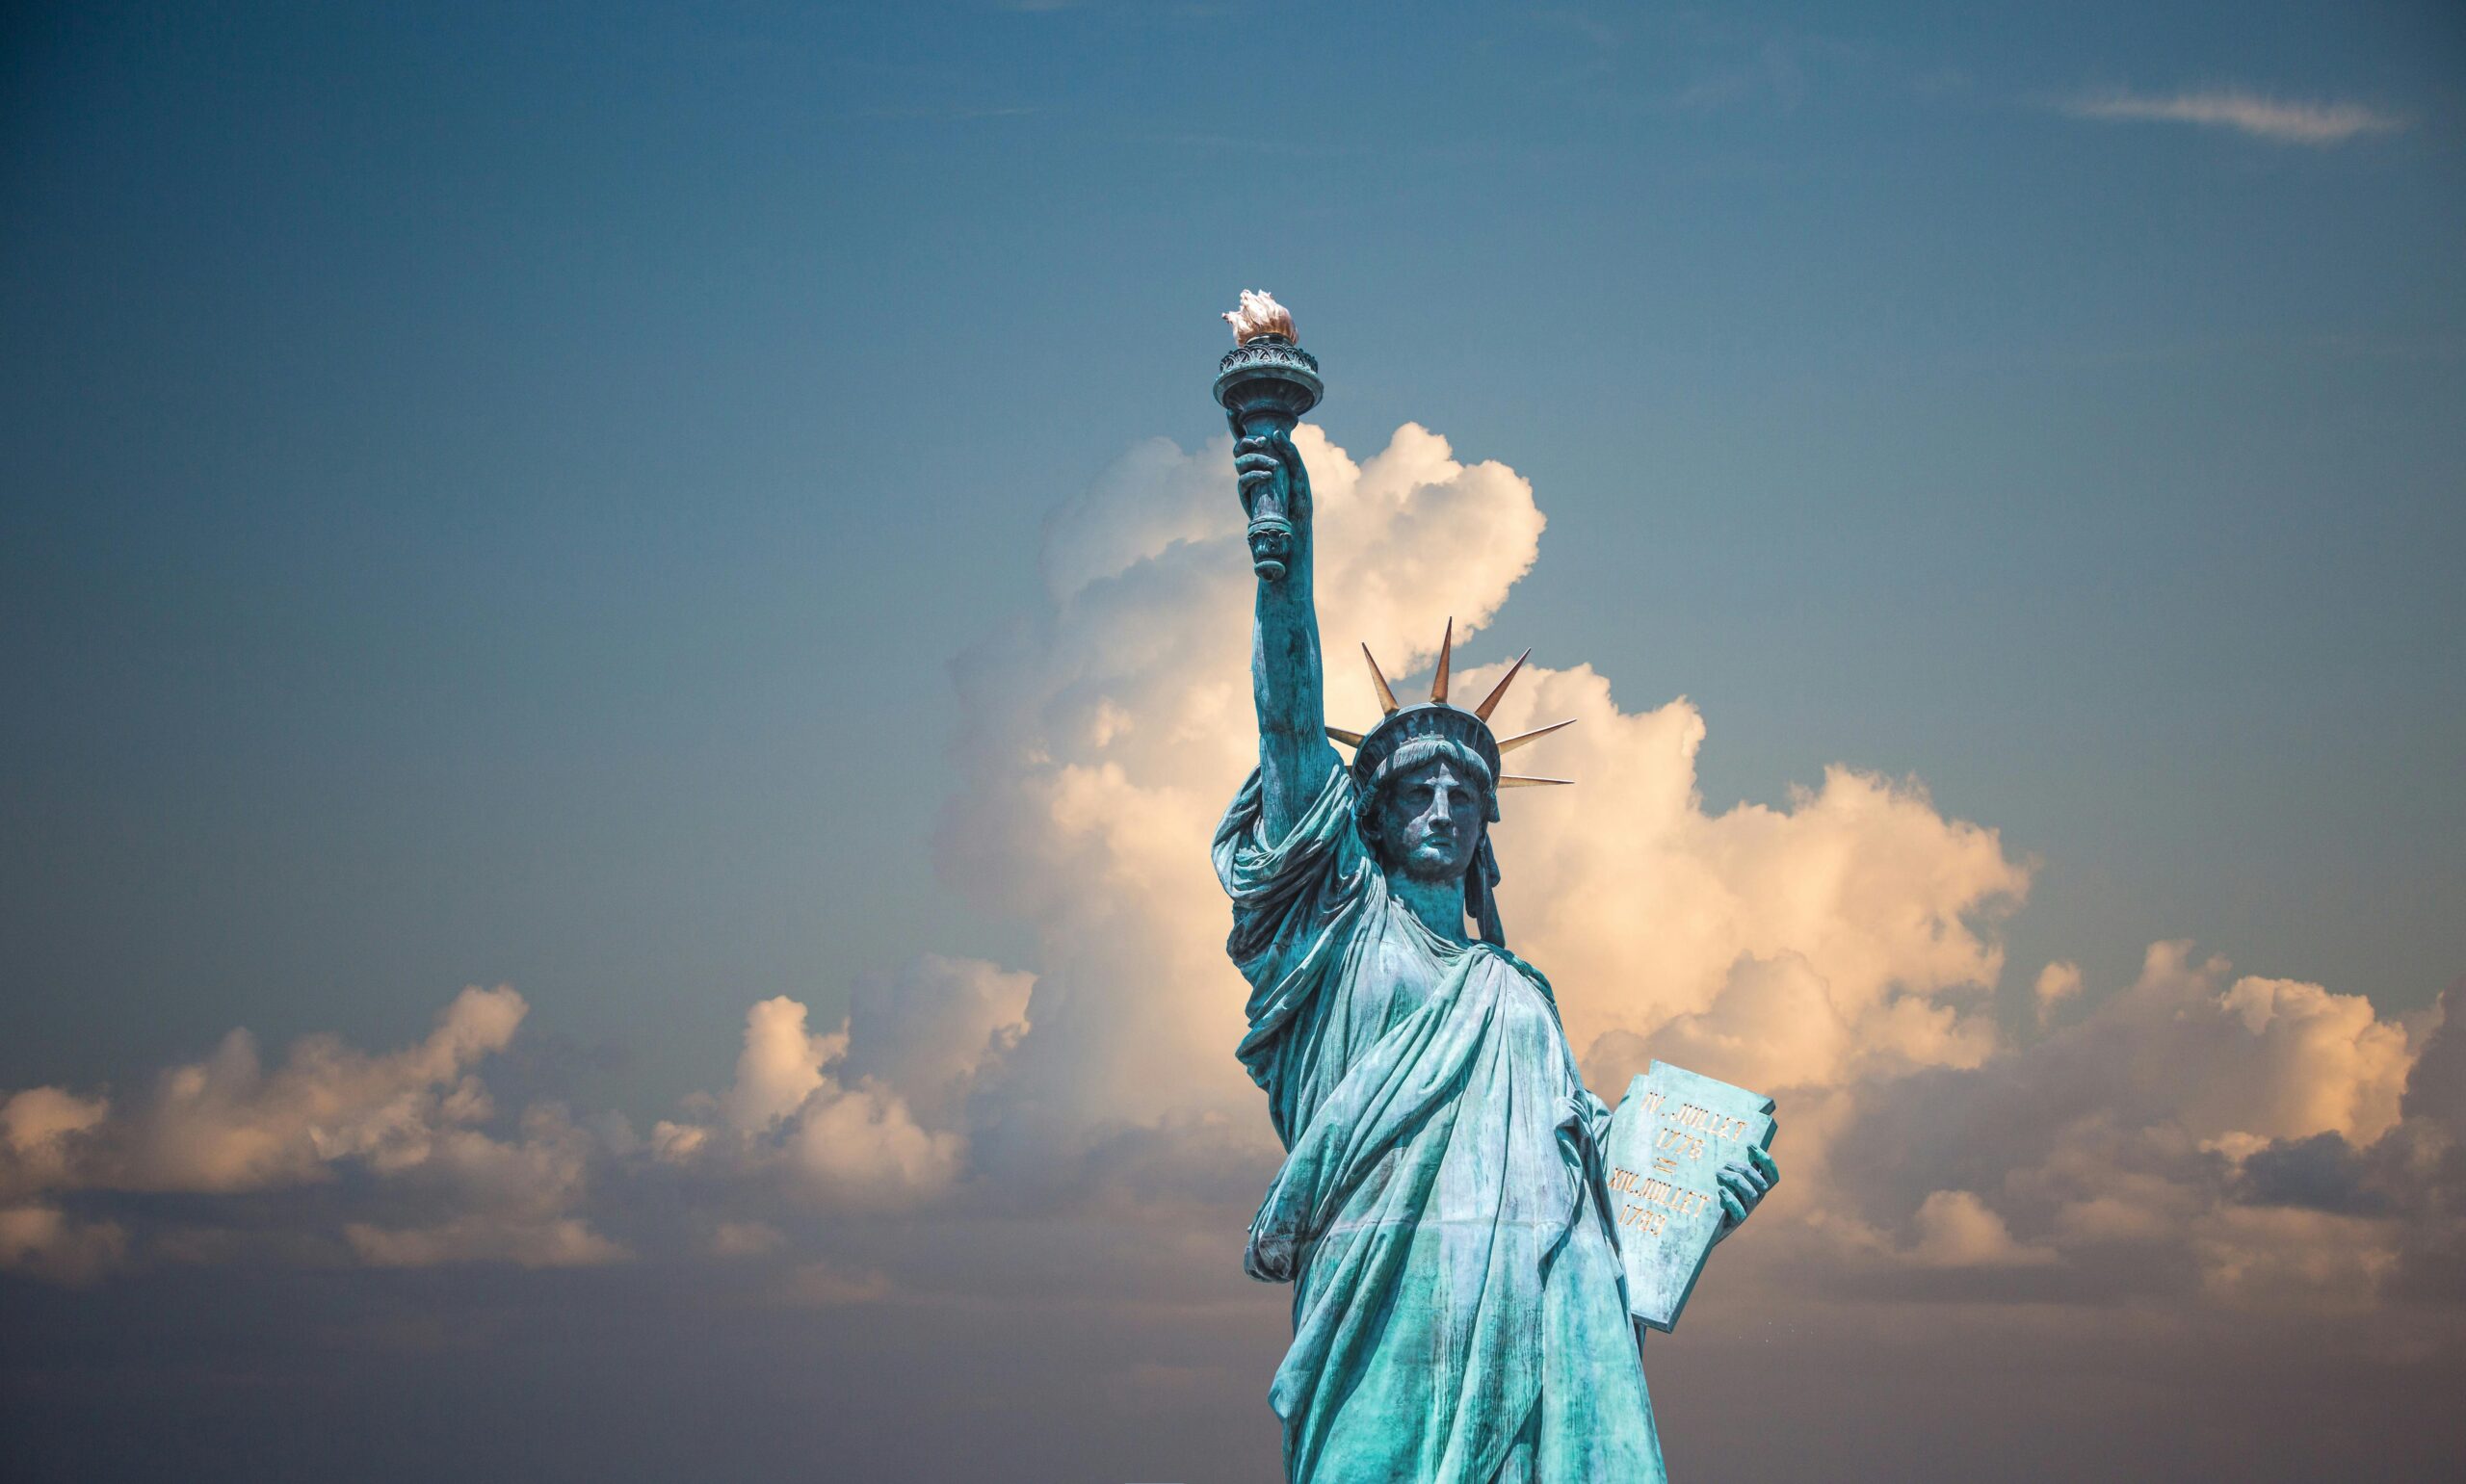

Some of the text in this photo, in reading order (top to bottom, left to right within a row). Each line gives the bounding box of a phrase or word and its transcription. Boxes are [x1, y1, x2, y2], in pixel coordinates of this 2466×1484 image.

[1671, 1104, 1748, 1141] JUILLET
[1656, 1128, 1704, 1159] 1776
[1618, 1204, 1666, 1237] 1789
